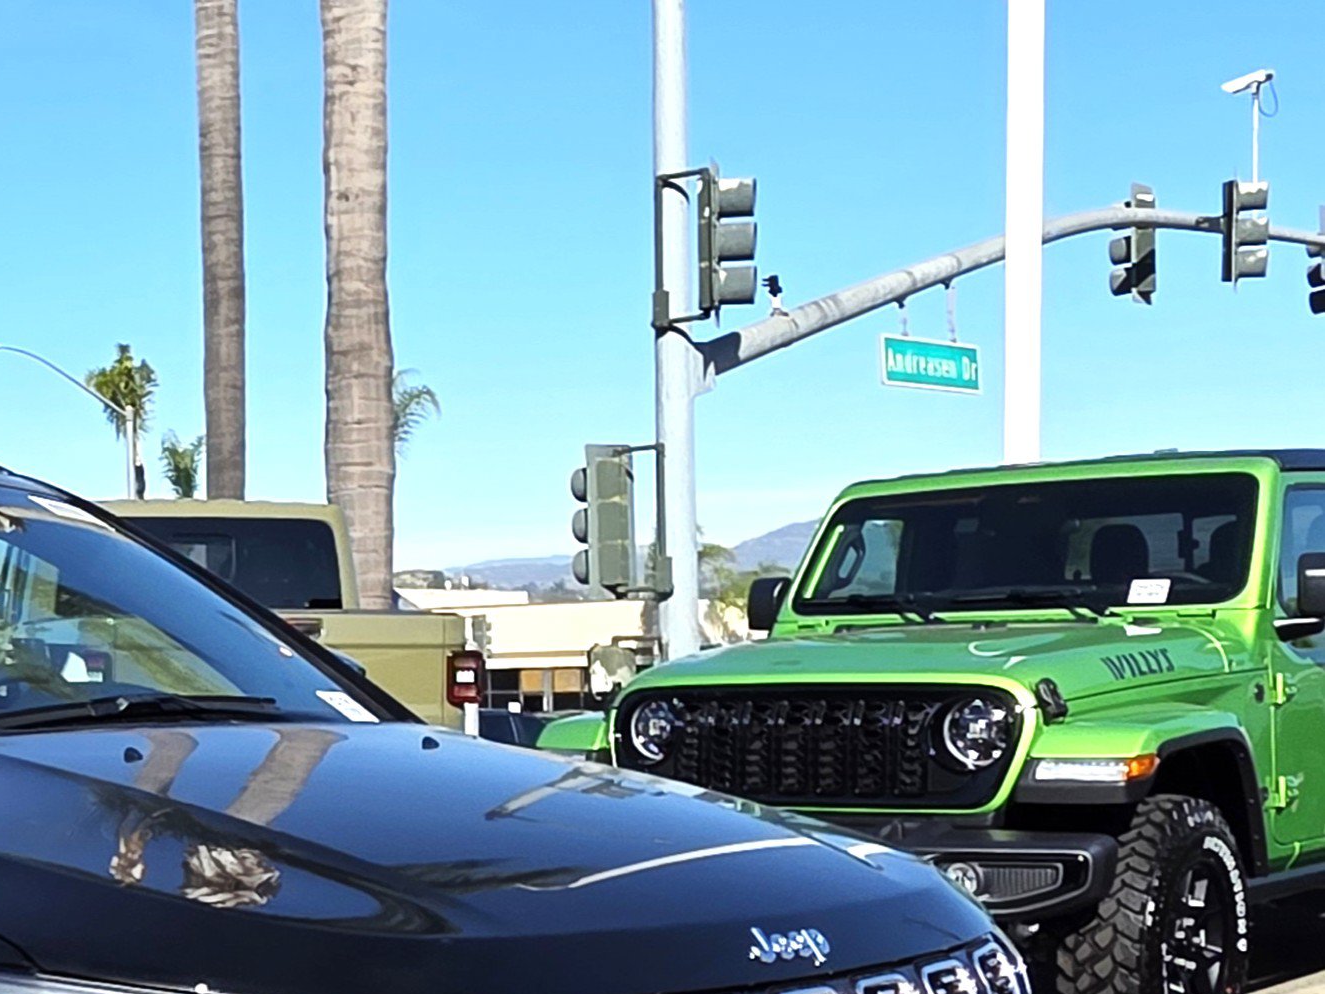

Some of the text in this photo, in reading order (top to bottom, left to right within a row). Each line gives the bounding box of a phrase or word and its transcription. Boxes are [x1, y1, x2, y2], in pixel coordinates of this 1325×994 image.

[887, 346, 978, 381] Andreasen Dr
[1099, 647, 1175, 680] WILLYS
[749, 926, 831, 967] Jeep
